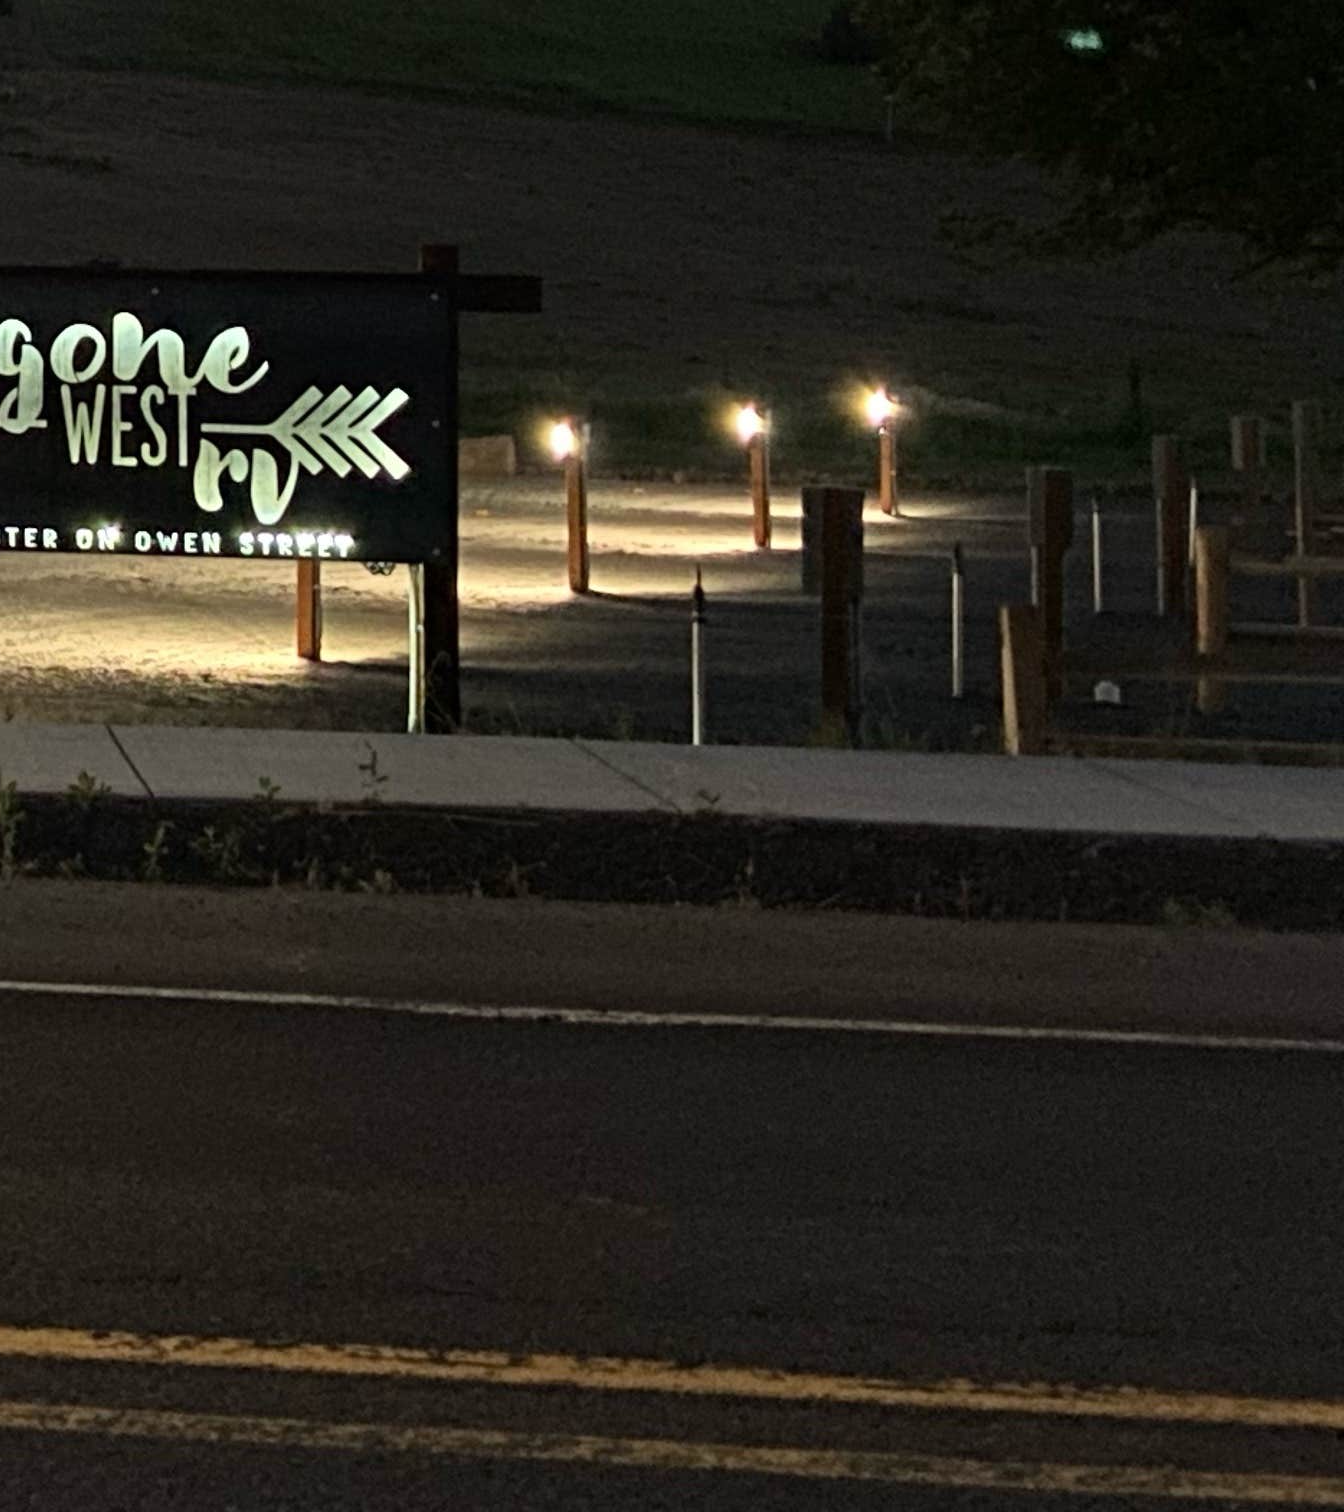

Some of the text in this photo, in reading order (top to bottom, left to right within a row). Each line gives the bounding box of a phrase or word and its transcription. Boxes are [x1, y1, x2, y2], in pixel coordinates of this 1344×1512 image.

[60, 384, 196, 466] WEST
[193, 438, 298, 525] rv
[75, 527, 118, 551] ON
[134, 531, 221, 554] OWEN
[239, 531, 355, 558] STREET
